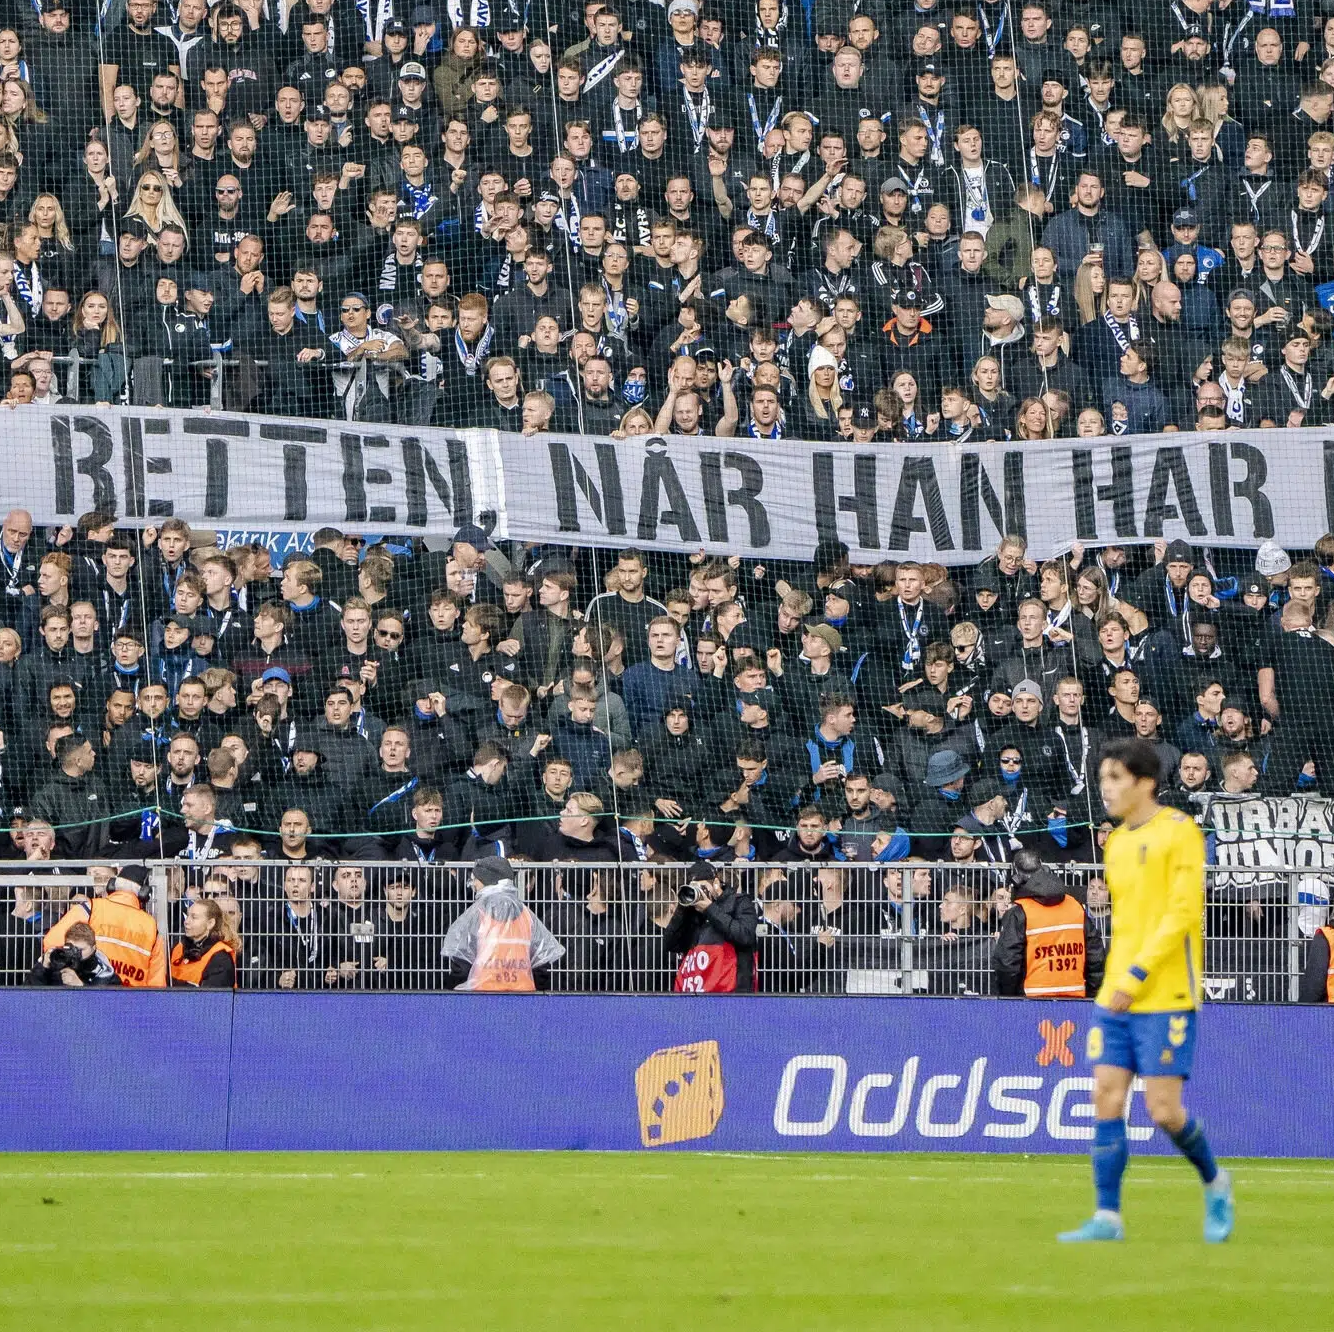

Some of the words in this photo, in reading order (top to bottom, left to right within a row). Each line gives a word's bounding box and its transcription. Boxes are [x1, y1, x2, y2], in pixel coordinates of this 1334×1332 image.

[548, 438, 771, 548] NÅR
[813, 450, 1028, 552] HAN
[1072, 443, 1276, 541] HAR
[1035, 941, 1084, 959] STEWARD
[1047, 959, 1078, 973] 1392
